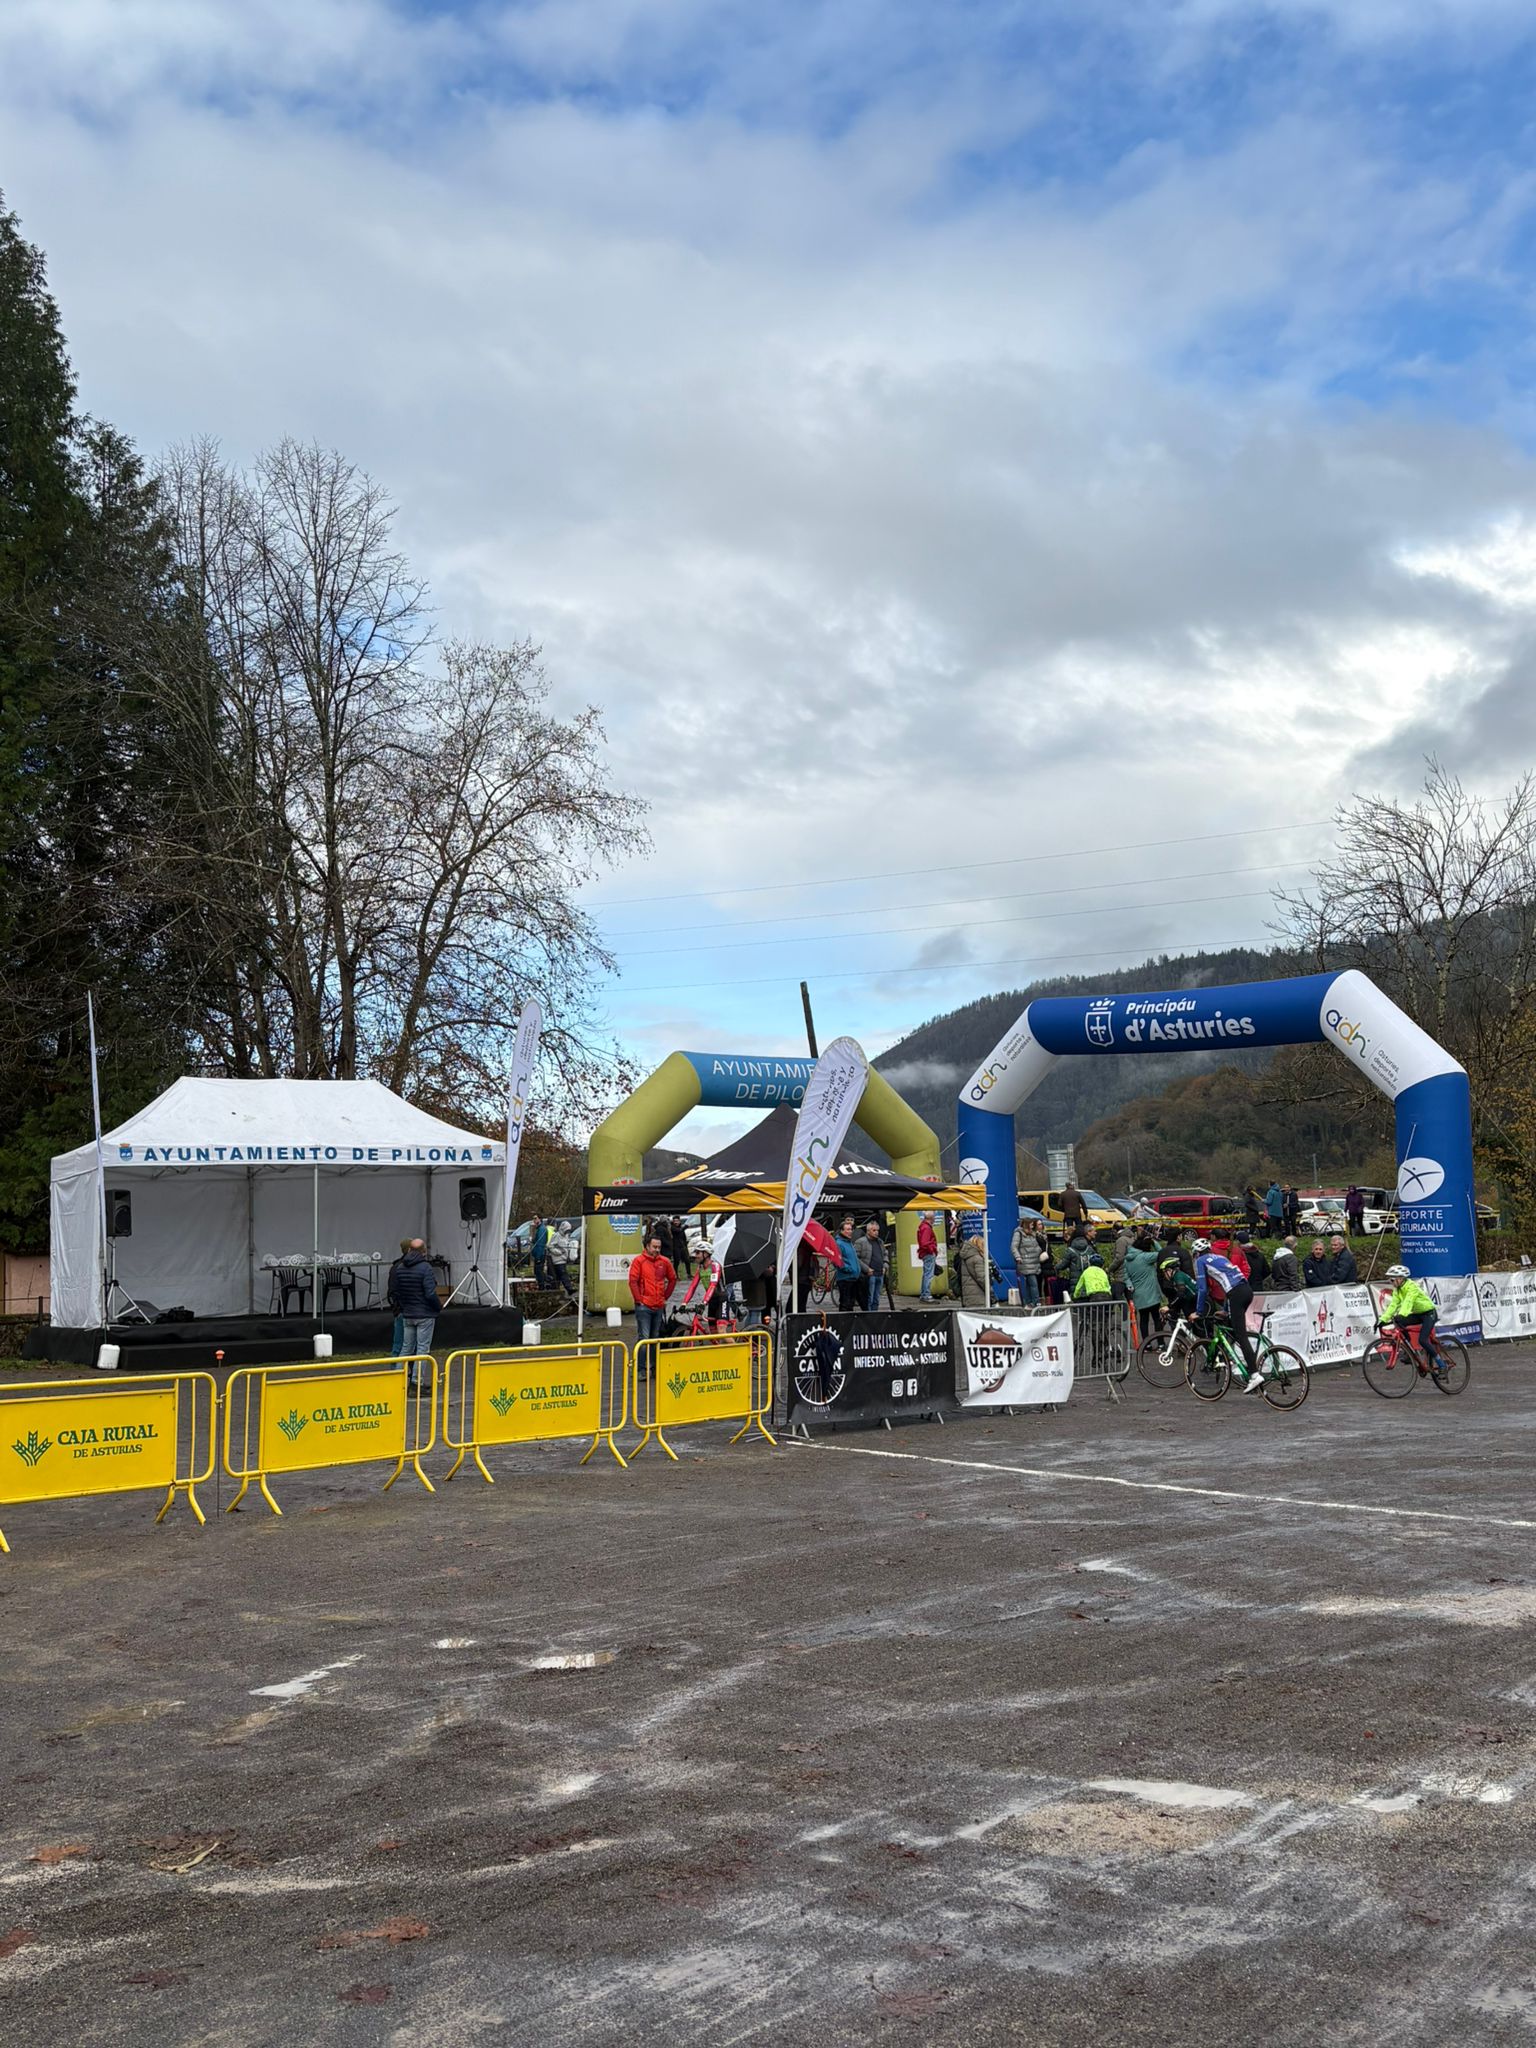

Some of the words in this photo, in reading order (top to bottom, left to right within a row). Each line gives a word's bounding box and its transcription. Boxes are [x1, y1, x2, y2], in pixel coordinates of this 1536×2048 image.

[1126, 997, 1196, 1015] Principáu
[1124, 1011, 1256, 1041] d'Asturies
[712, 1059, 814, 1079] AYUNTAMIE
[735, 1083, 761, 1099] DE
[764, 1085, 805, 1101] PILO
[144, 1146, 337, 1161] AYUNTAMIENTO
[352, 1147, 379, 1161] DE
[391, 1145, 472, 1161] PILOÑA
[687, 1168, 765, 1181] thor
[838, 1162, 896, 1177] thor
[601, 1197, 629, 1208] thor
[1401, 1222, 1443, 1232] STURIANU
[901, 1329, 947, 1349] CAYÓN
[799, 1357, 842, 1373] CAN
[854, 1355, 885, 1369] INFIESTO
[890, 1352, 915, 1367] PILOÑA
[920, 1351, 947, 1364] ASTURIAS
[690, 1371, 711, 1384] CAJA
[712, 1368, 741, 1382] RURAL
[520, 1387, 548, 1400] CAJA
[550, 1383, 588, 1398] RURAL
[697, 1385, 706, 1393] DE
[706, 1383, 734, 1393] ASTURIAS
[312, 1406, 345, 1422] CAJA
[348, 1402, 392, 1418] RURAL
[530, 1402, 541, 1411] DE
[542, 1399, 578, 1410] ASTURIAS
[57, 1430, 97, 1445] CAJA
[102, 1424, 158, 1442] RURAL
[324, 1424, 337, 1433] DE
[338, 1420, 380, 1433] ASTURIAS
[73, 1448, 89, 1459] DE
[90, 1443, 143, 1458] ASTURIAS
